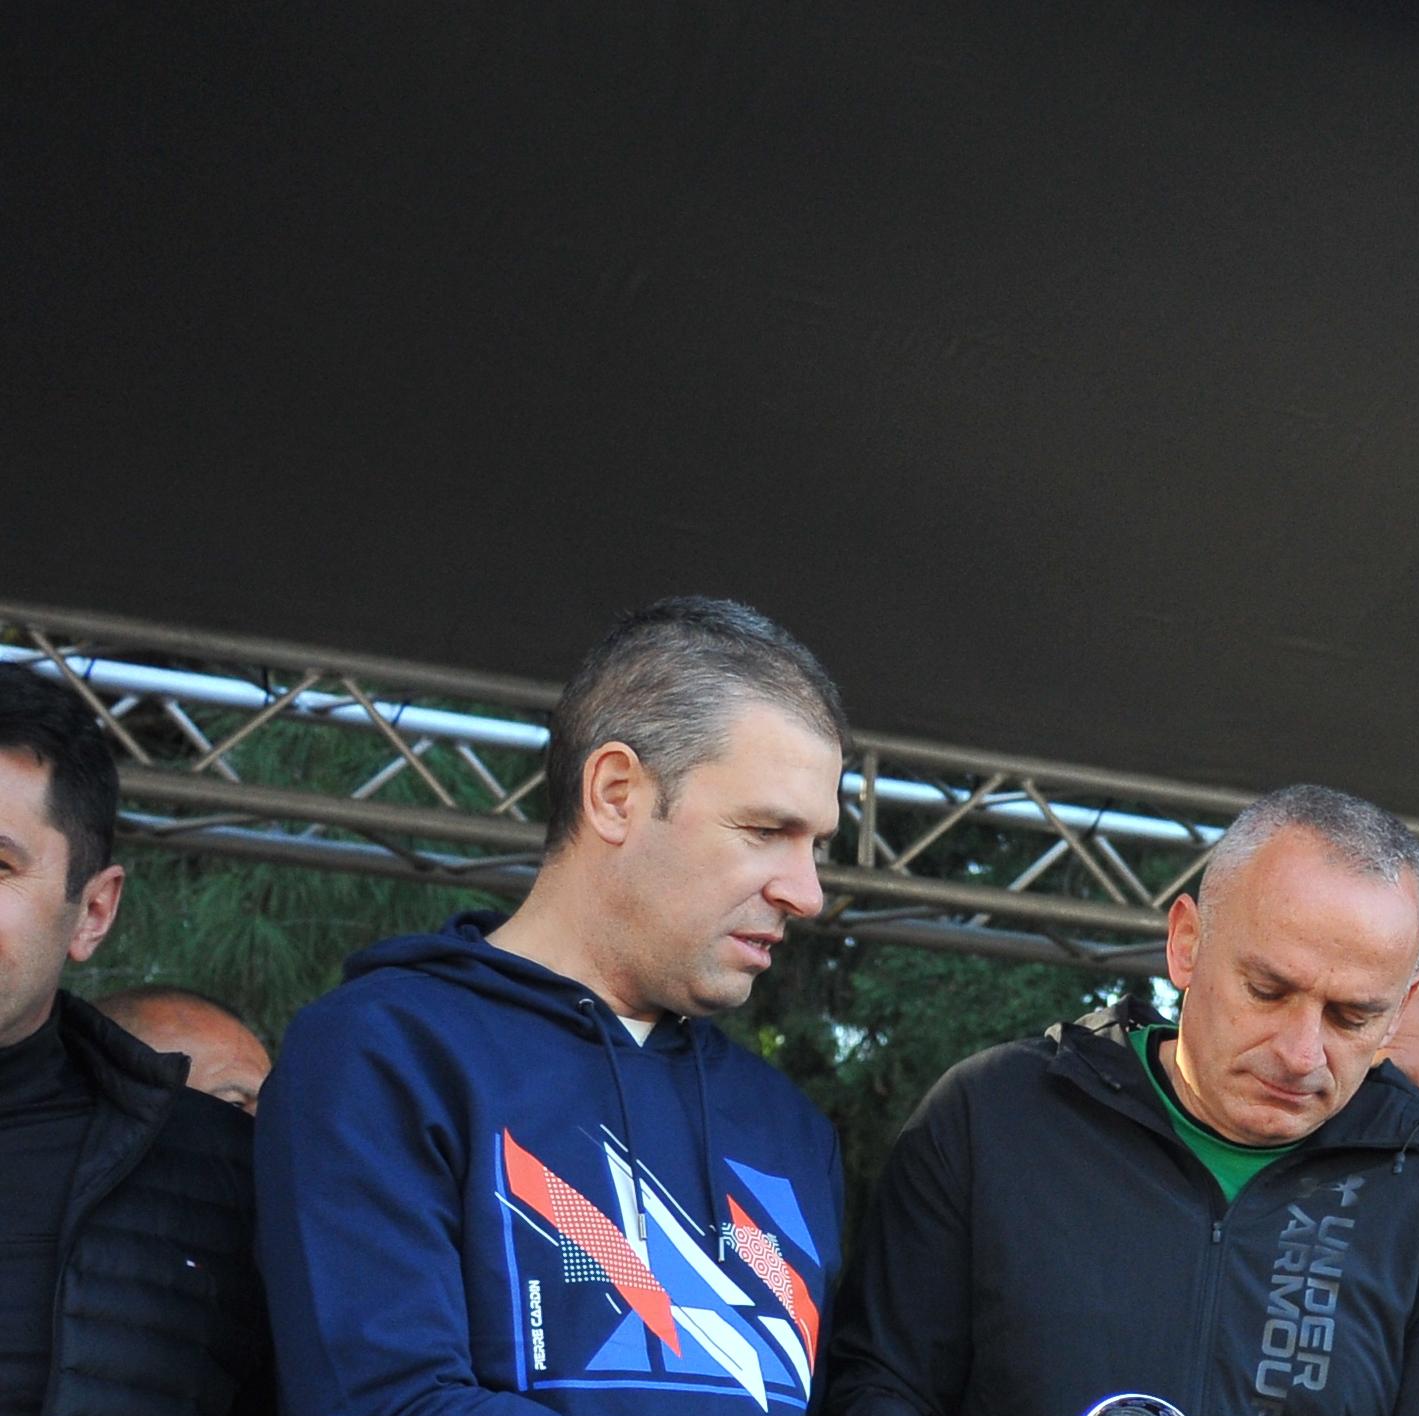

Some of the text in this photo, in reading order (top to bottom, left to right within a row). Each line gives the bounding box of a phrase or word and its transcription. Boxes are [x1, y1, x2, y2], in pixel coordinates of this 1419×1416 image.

[528, 1279, 547, 1370] PIERRE CARDIN
[1293, 1215, 1355, 1392] UNDER
